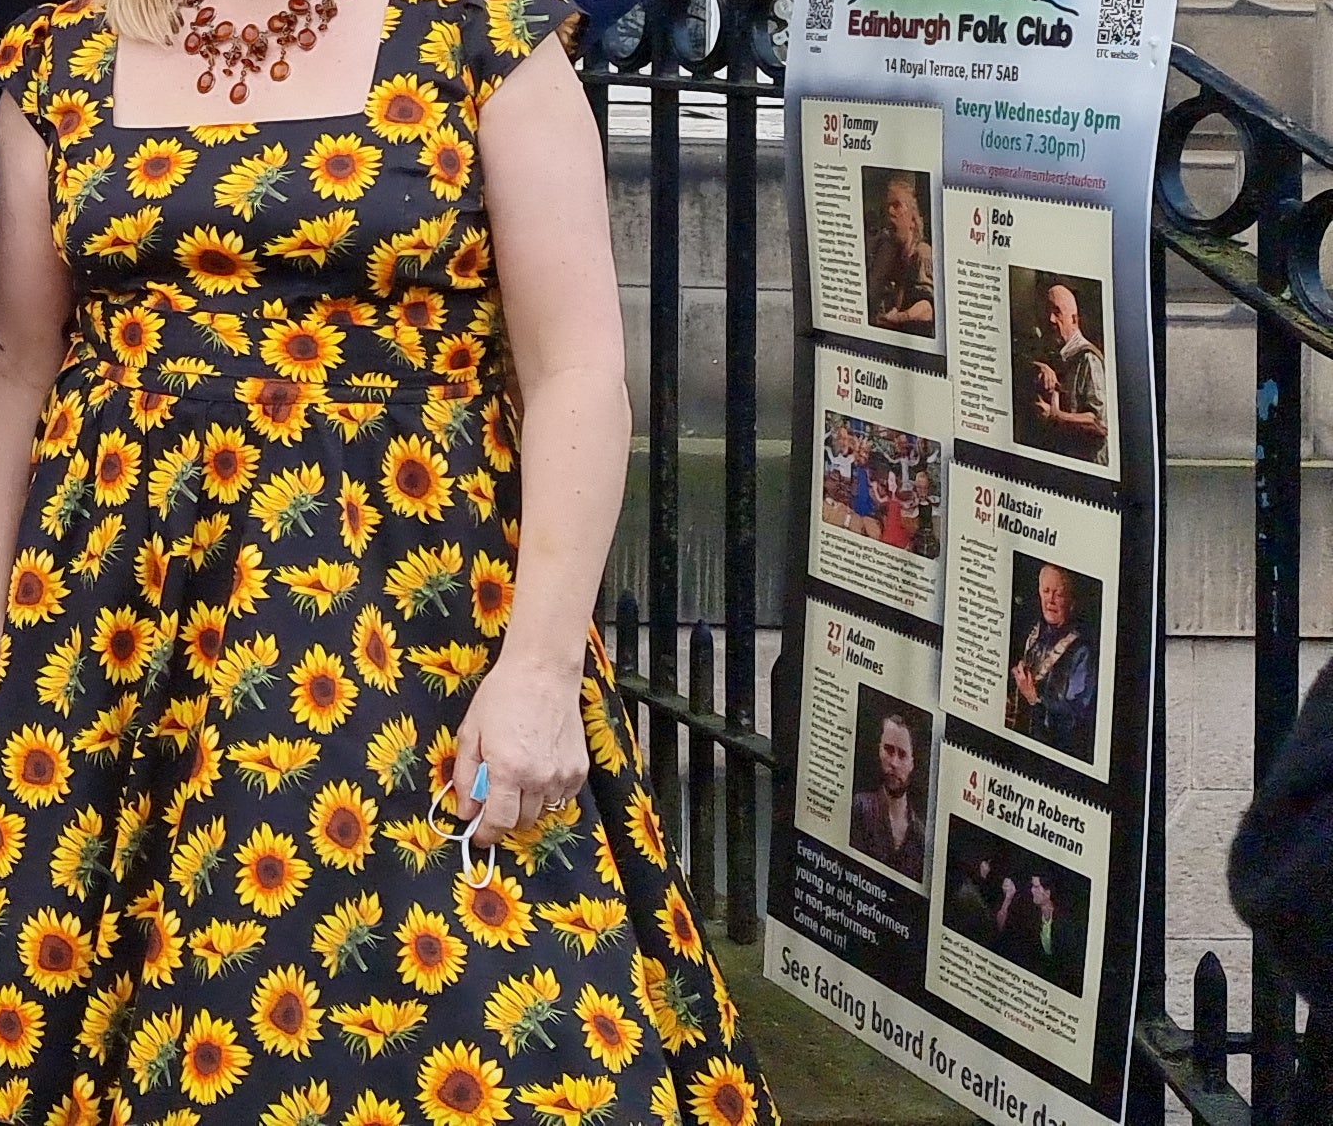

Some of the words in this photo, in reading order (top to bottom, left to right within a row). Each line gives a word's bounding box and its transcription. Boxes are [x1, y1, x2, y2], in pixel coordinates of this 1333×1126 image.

[848, 9, 951, 46] Edinburgh
[957, 14, 1008, 44] Folk
[1016, 16, 1073, 48] Club
[885, 58, 897, 73] 14
[899, 59, 927, 79] Royal
[929, 60, 969, 81] Terrace,
[971, 64, 993, 80] EH7
[996, 65, 1019, 81] 5AB
[823, 113, 838, 132] 30
[842, 113, 879, 136] Tommy
[955, 97, 992, 127] Every
[994, 100, 1082, 131] Wednesday
[1084, 107, 1121, 132] 8pm
[823, 133, 839, 146] Mar
[843, 133, 872, 151] Sands
[980, 132, 1023, 154] (doors
[1025, 134, 1086, 162] 7.30pm)
[973, 207, 981, 226] 6
[991, 209, 1014, 227] Bob
[969, 228, 986, 245] Apr
[992, 230, 1011, 248] Fox
[836, 365, 850, 384] 13
[854, 369, 888, 391] Ceilidh
[836, 385, 849, 401] Apr
[854, 388, 883, 410] Dance
[974, 486, 992, 507] 20
[997, 491, 1044, 520] Alastair
[974, 507, 991, 523] Apr
[997, 512, 1057, 547] McDonald
[827, 621, 842, 641] 27
[846, 627, 876, 651] Adam
[827, 640, 841, 658] Apr
[846, 647, 884, 676] Holmes
[968, 770, 978, 789] 4
[963, 788, 982, 814] May
[987, 776, 1034, 812] Kathryn
[1036, 799, 1086, 834] Roberts
[986, 799, 996, 816] &
[997, 802, 1024, 831] Seth
[1027, 821, 1084, 857] Lakeman
[797, 840, 844, 881] Everybody
[845, 870, 887, 902] welcome
[795, 865, 824, 895] young
[825, 882, 835, 896] or
[836, 887, 856, 910] old,
[856, 899, 910, 940] performers
[793, 906, 819, 934] Come
[820, 925, 832, 942] on
[833, 930, 847, 950] in!
[794, 887, 804, 901] or
[805, 893, 880, 946] non-performers.
[780, 946, 809, 986] See
[814, 965, 866, 1031] facing
[872, 1001, 924, 1061] board
[929, 1037, 957, 1080] for
[961, 1069, 1028, 1124] earlier
